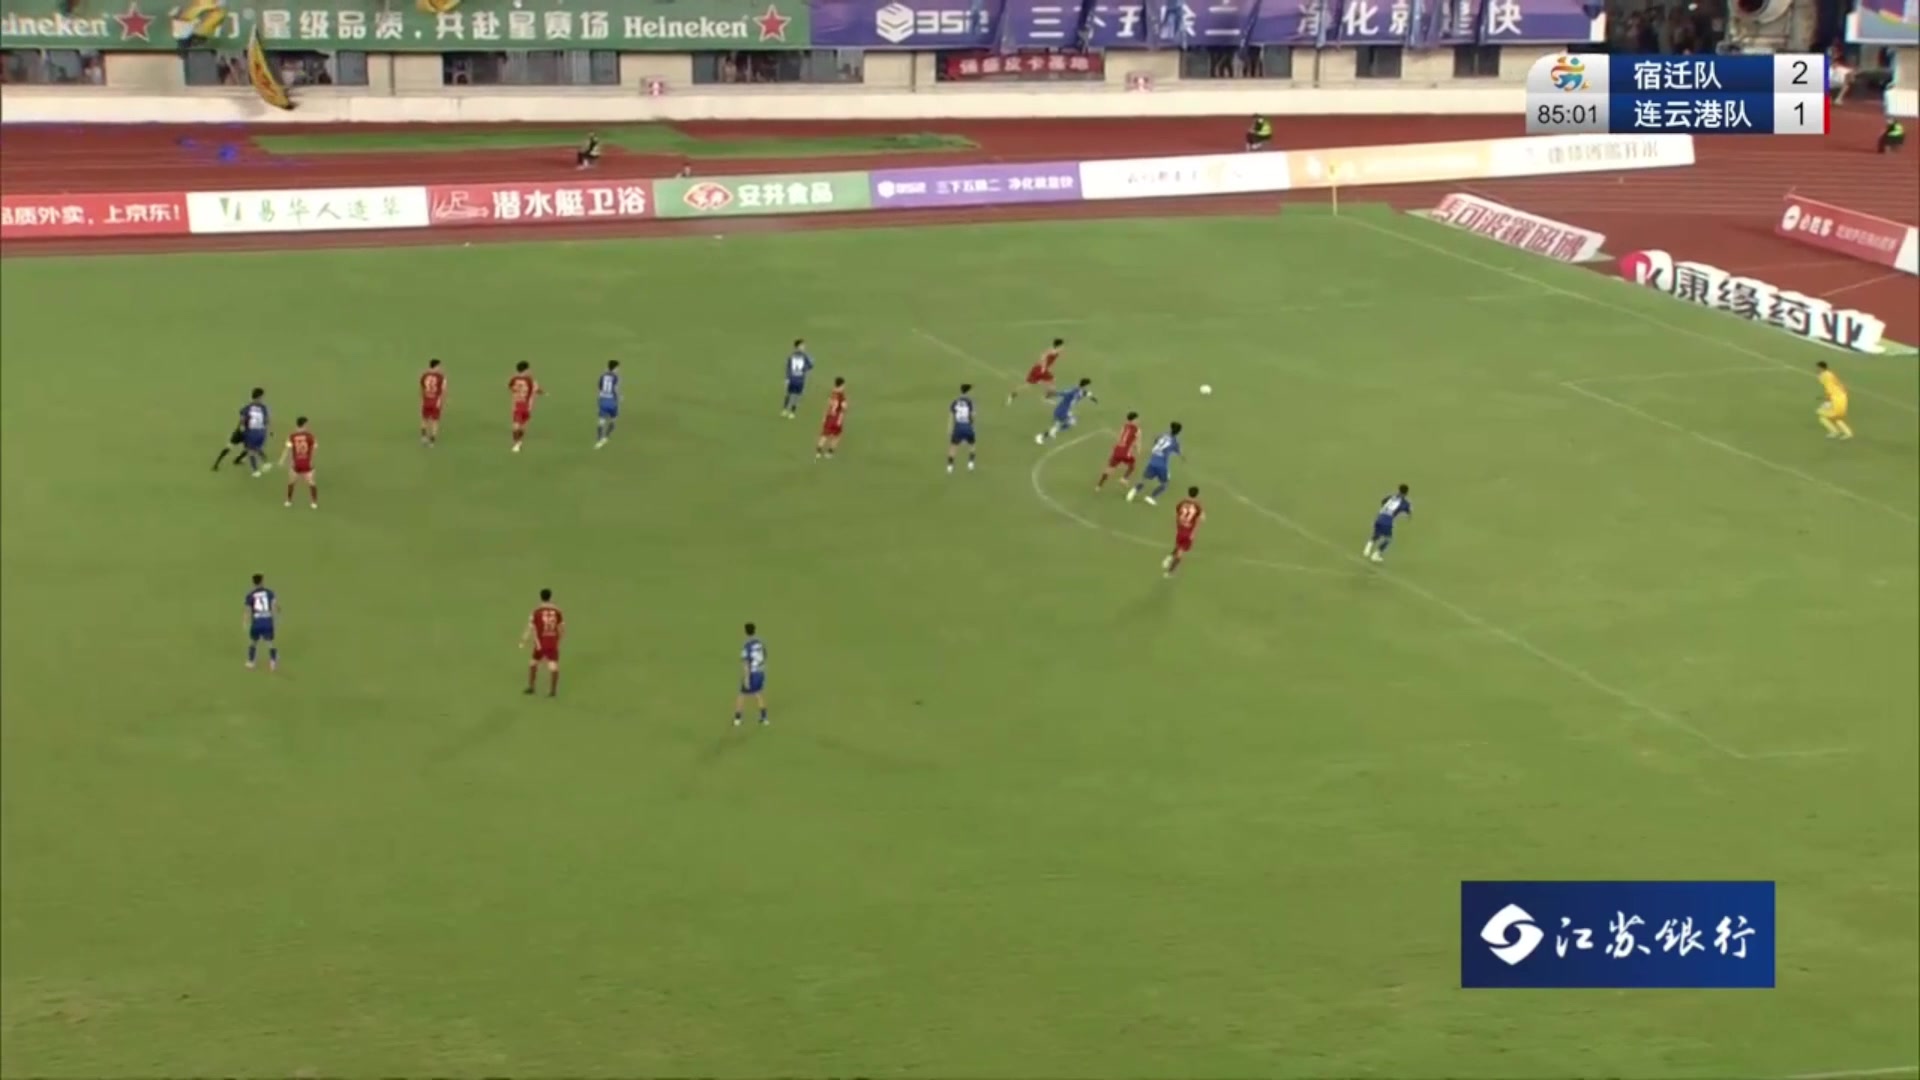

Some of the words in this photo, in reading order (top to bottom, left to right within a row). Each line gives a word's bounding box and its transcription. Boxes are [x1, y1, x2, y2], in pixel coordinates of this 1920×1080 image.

[624, 15, 748, 39] Heineken
[493, 188, 646, 219] 潜水艇卫浴
[738, 181, 833, 207] 安井食品
[1670, 264, 1863, 350] 康缘药业
